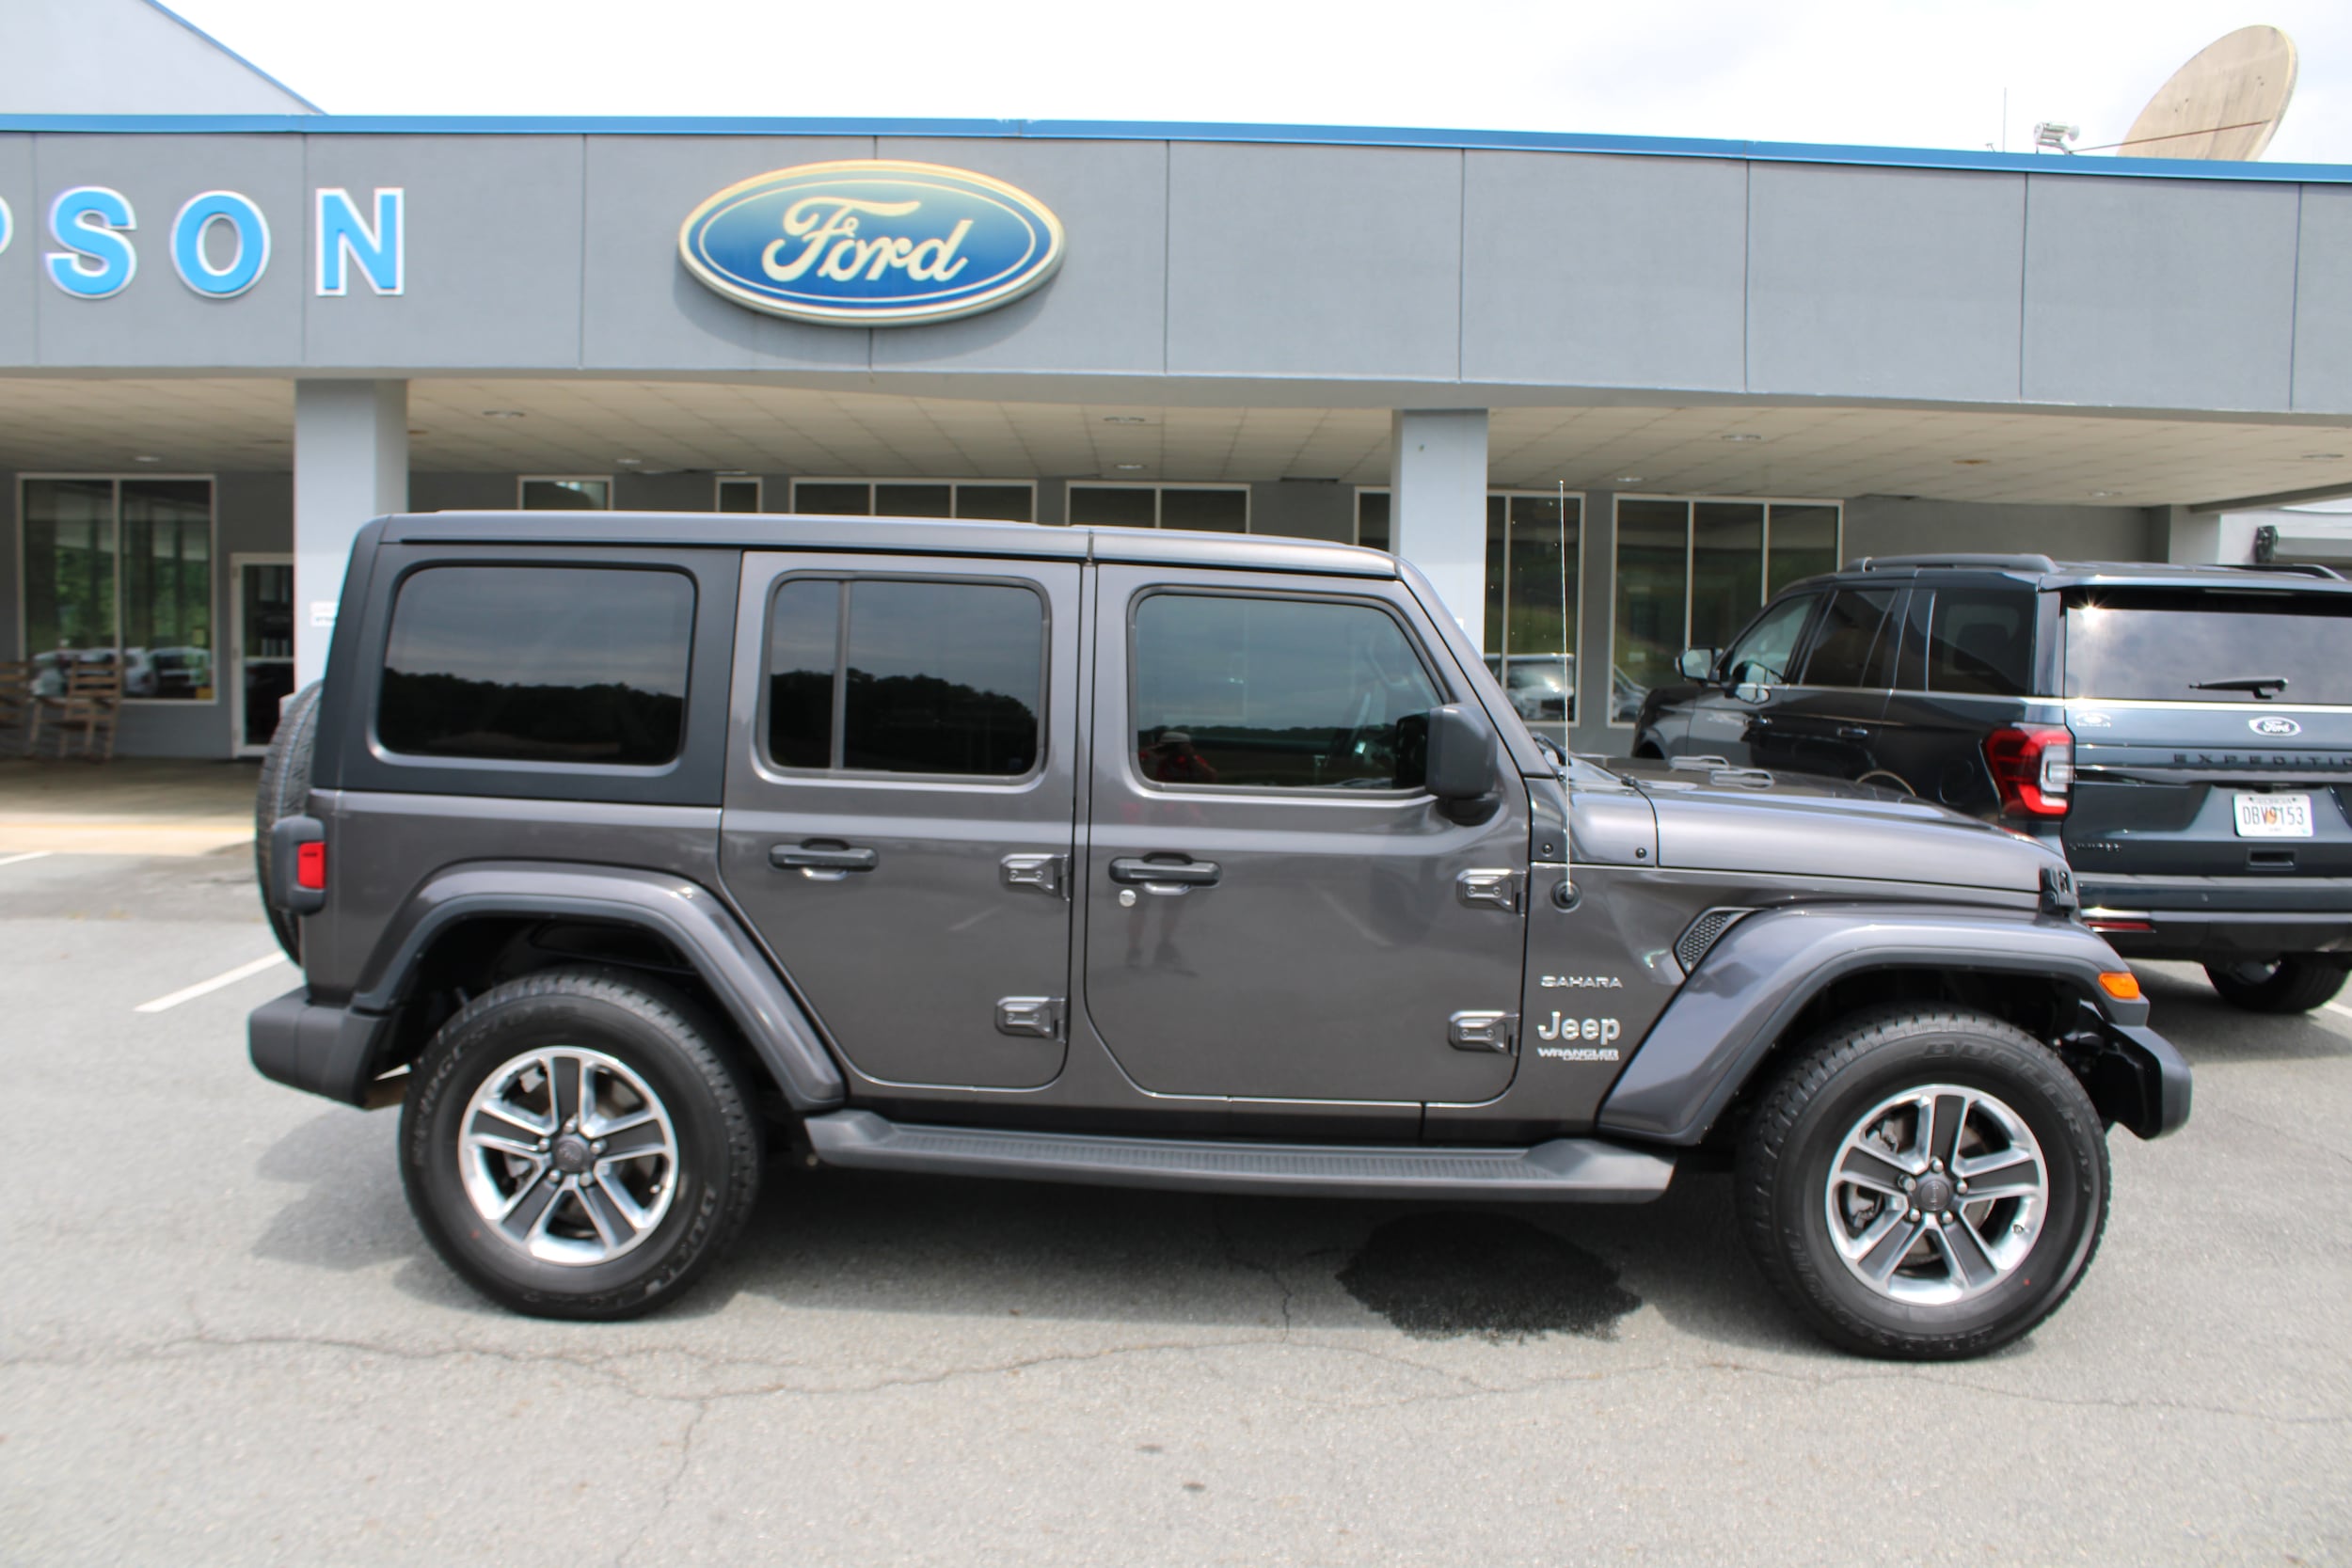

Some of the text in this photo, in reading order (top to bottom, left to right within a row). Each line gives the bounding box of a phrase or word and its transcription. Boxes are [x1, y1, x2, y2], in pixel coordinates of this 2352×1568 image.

[0, 185, 405, 299] SON
[761, 196, 974, 282] Ford
[1540, 975, 1623, 988] SAHARA
[1537, 1011, 1621, 1045] Jeep
[1537, 1047, 1619, 1057] WRANGLER
